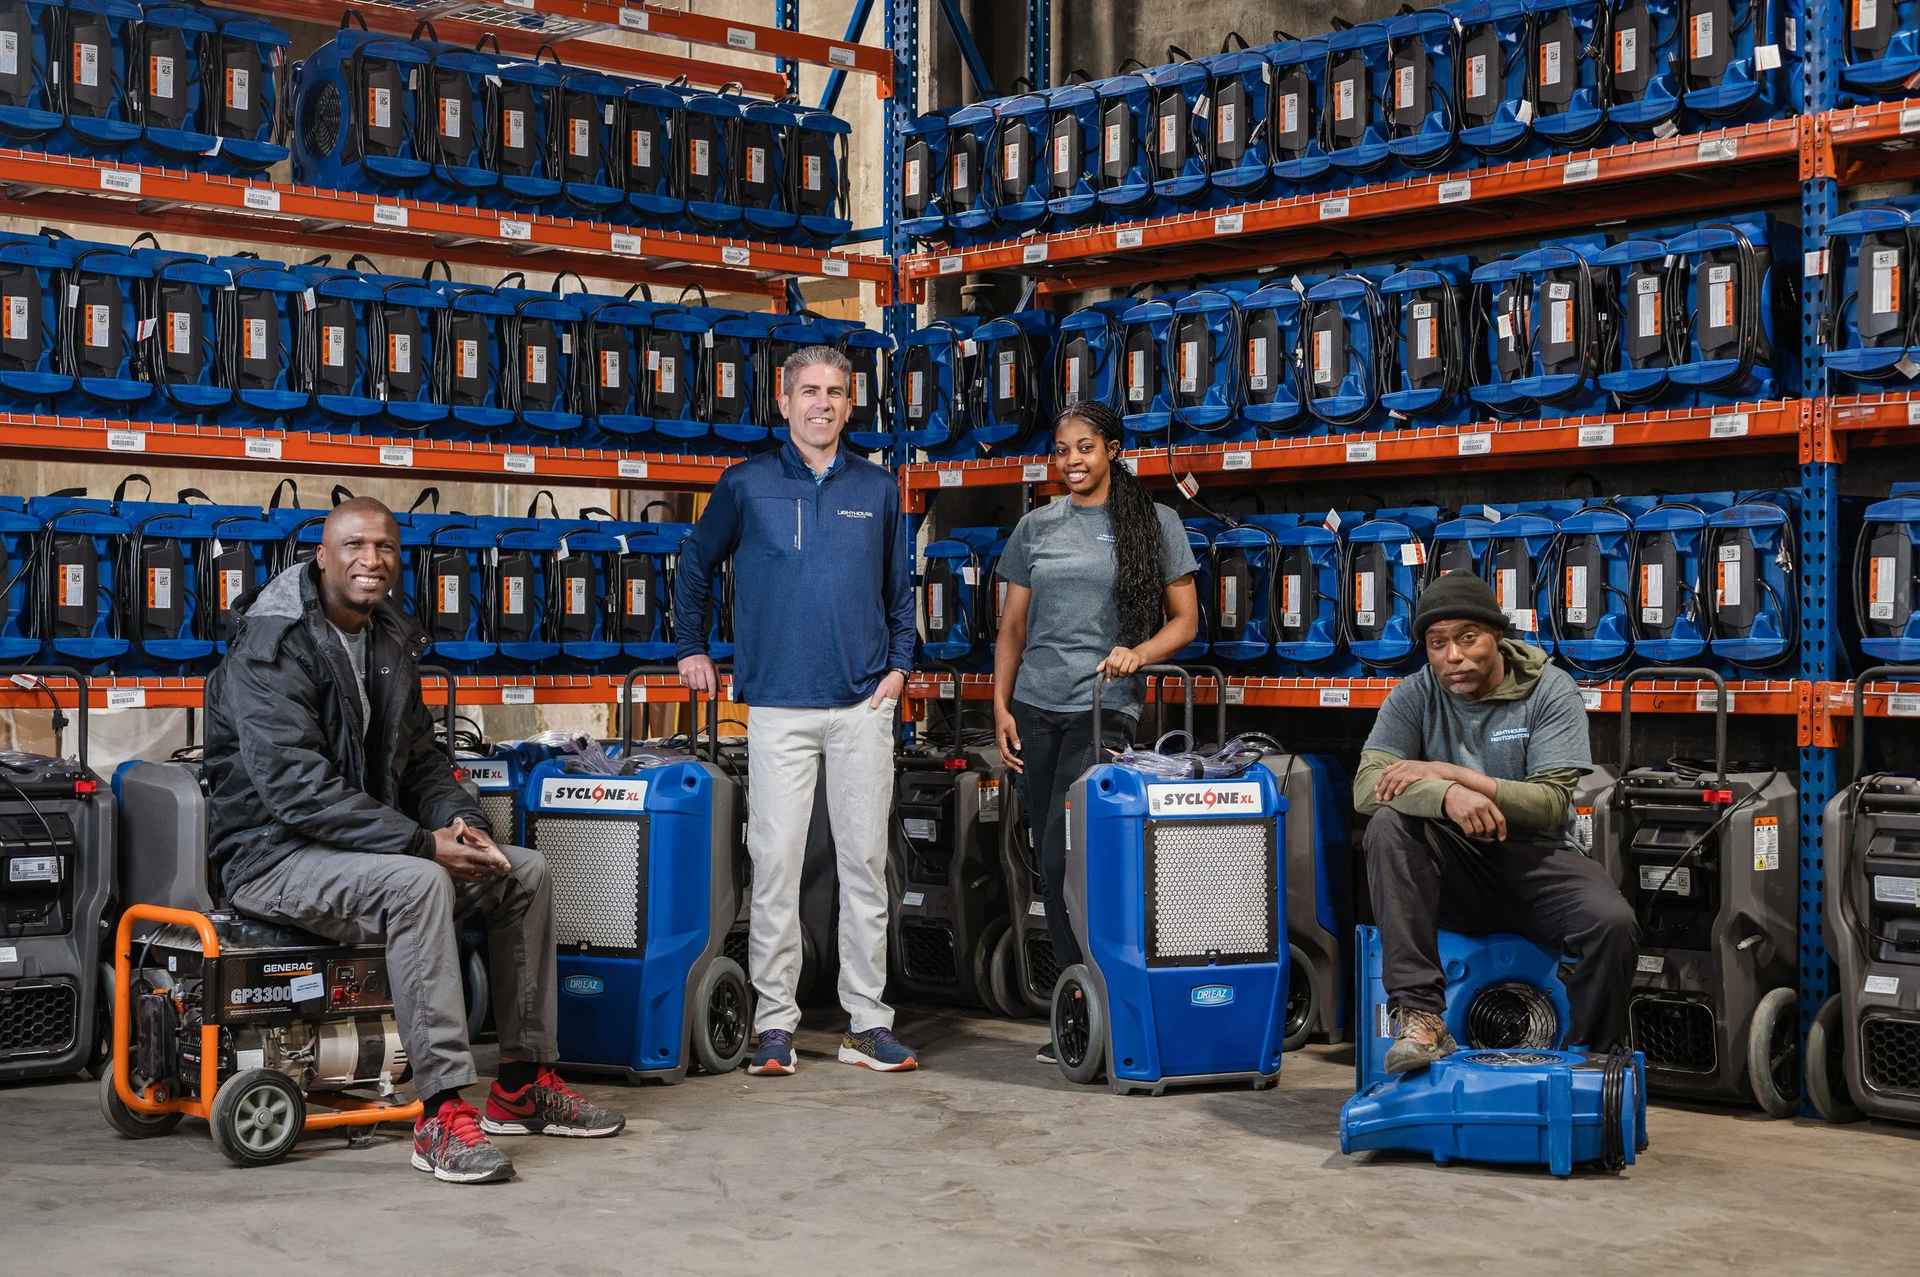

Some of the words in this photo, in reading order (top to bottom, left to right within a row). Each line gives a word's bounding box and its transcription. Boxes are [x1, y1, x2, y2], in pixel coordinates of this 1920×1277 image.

[108, 174, 133, 182] SB3105037
[837, 509, 873, 517] LIGHTHOUSE
[1653, 694, 1665, 709] 6
[1871, 697, 1884, 713] 7
[1490, 733, 1529, 742] RESTORATION
[1493, 727, 1527, 737] LIGHTHOUSE
[491, 770, 503, 780] XL
[555, 782, 626, 806] SYCLONE
[626, 790, 640, 802] XL
[1164, 787, 1239, 810] SYCLONE
[1240, 795, 1254, 804] XL
[263, 962, 313, 974] GENERAC
[230, 985, 292, 1005] GP3300
